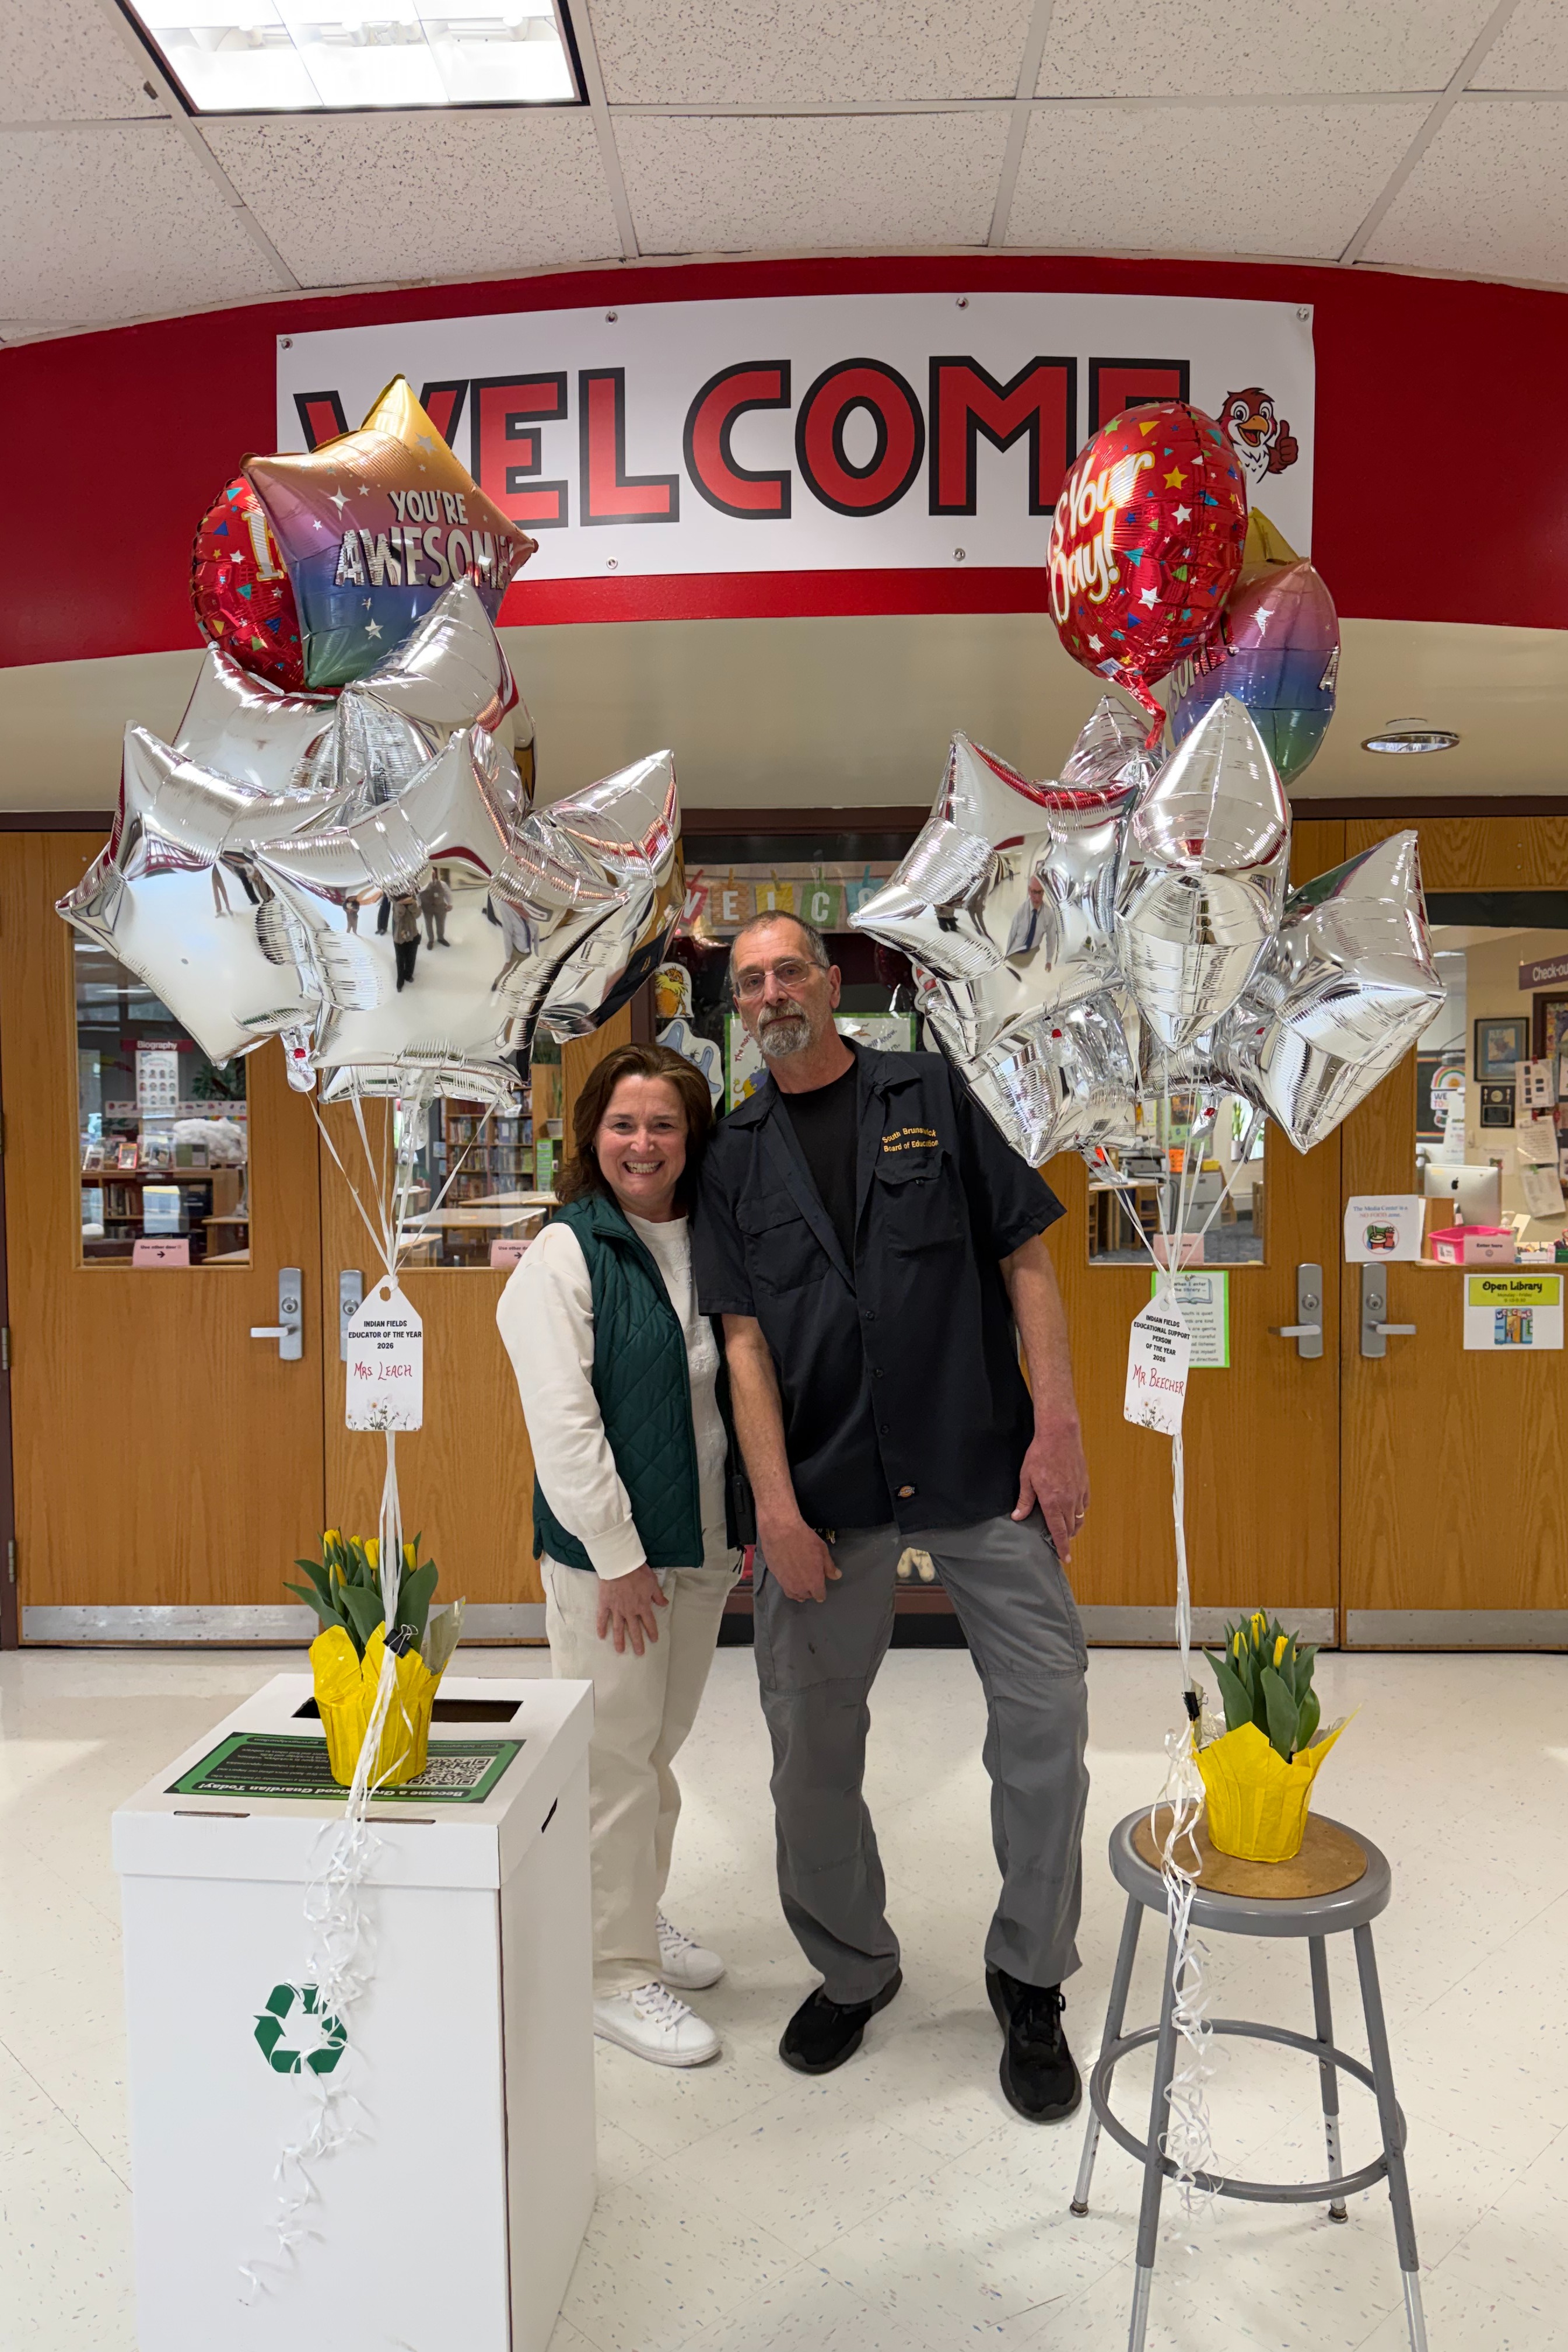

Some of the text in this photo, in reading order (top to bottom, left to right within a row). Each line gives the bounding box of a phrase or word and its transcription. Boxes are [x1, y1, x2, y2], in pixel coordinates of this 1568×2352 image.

[387, 489, 469, 525] YOU'RE
[1050, 506, 1121, 626] Day!
[136, 1041, 177, 1050] Biography
[882, 1127, 936, 1143] South Brunswick
[883, 1143, 902, 1152] Board
[911, 1139, 939, 1148] Education
[1482, 1281, 1543, 1293] Open Library
[1146, 1315, 1180, 1328] INDIAN FIELDS
[1133, 1321, 1190, 1340] EDUCATIONAL SUPPORT
[1152, 1335, 1171, 1345] PERSON
[1153, 1344, 1163, 1352] THE
[1163, 1347, 1176, 1356] YEAR
[1153, 1354, 1166, 1363] 2026
[377, 1361, 412, 1381] LEACH
[1149, 1367, 1185, 1396] BEECHER
[198, 1782, 246, 1791] Today!
